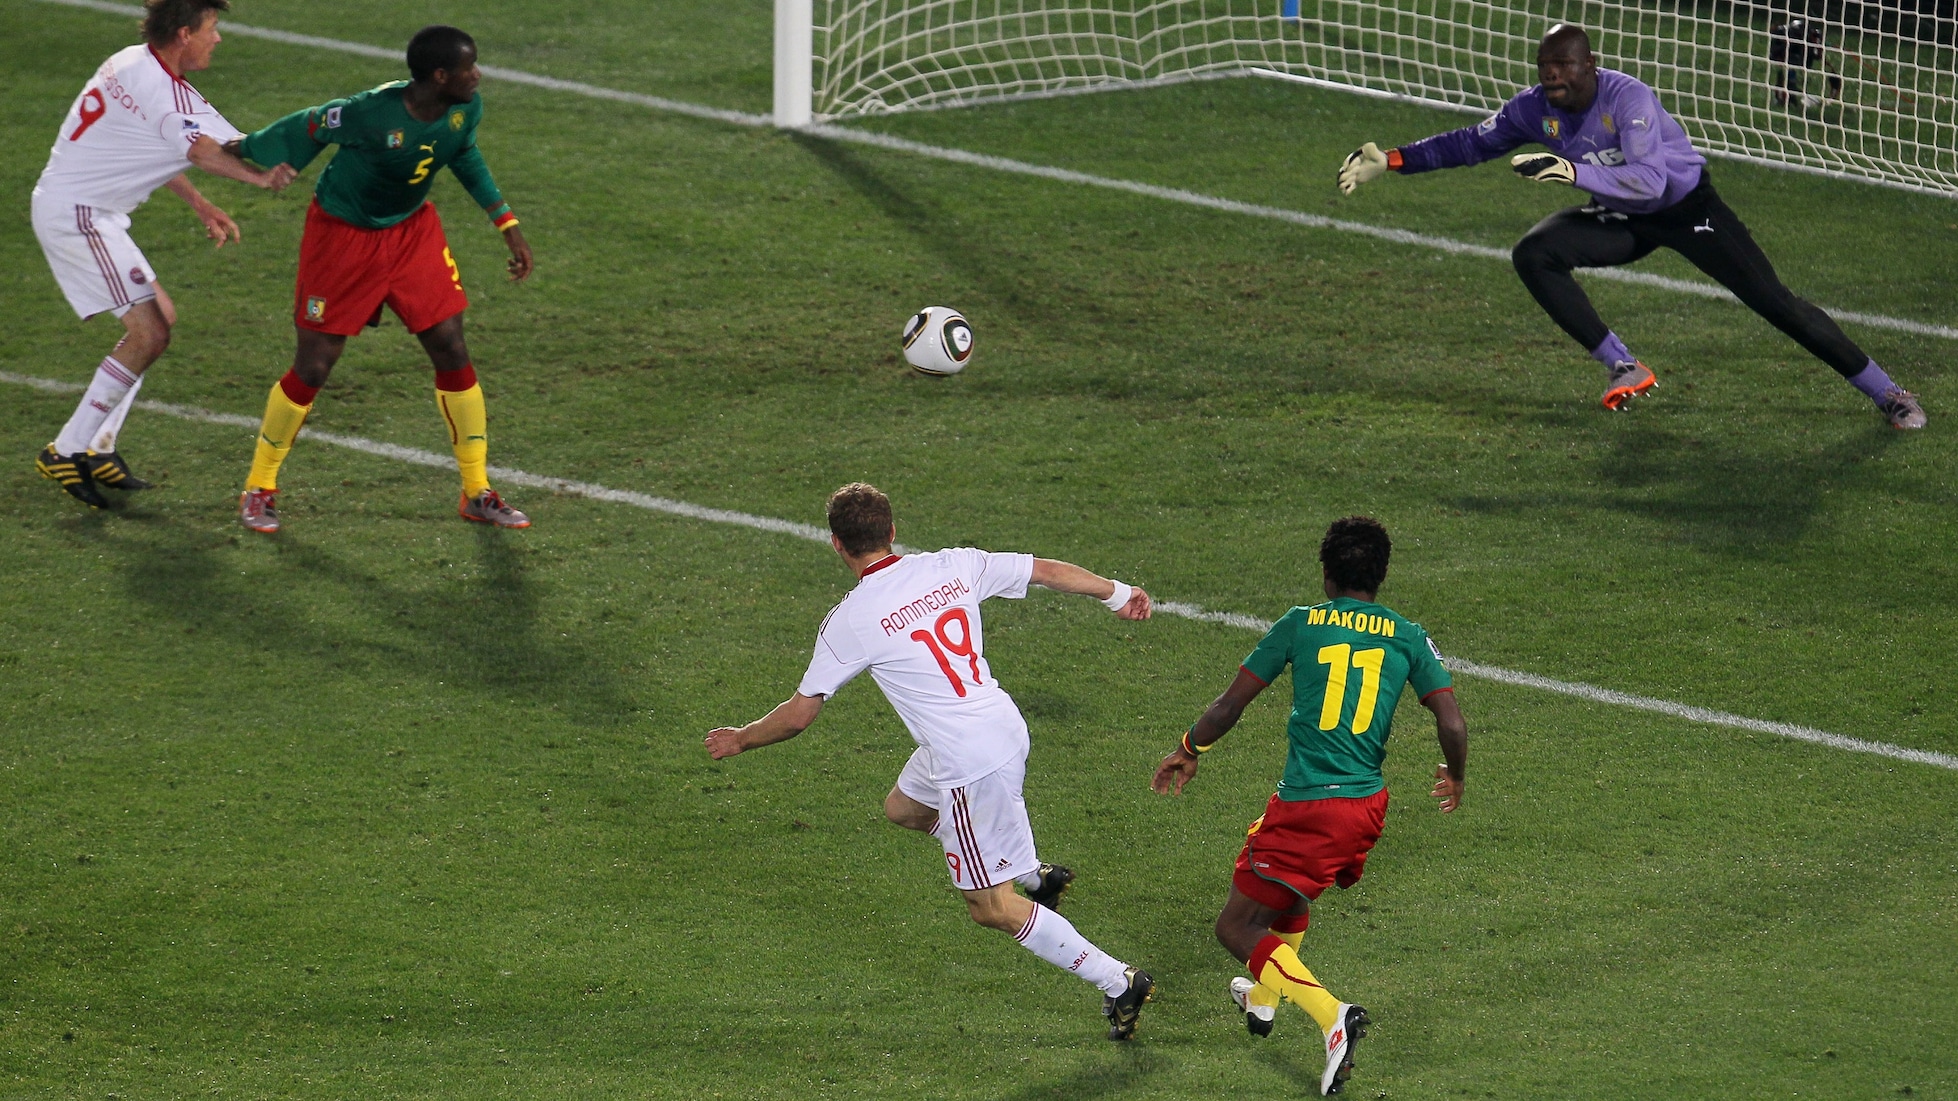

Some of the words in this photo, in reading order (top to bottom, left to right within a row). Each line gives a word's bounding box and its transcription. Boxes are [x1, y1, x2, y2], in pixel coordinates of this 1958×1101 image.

[69, 87, 106, 142] 9
[408, 157, 434, 185] 5
[1581, 147, 1625, 167] 16
[442, 247, 459, 282] 5
[880, 577, 970, 637] ROMMEDAHL
[1307, 608, 1396, 638] MAKOUN
[910, 607, 983, 698] 19
[1317, 643, 1385, 735] 11
